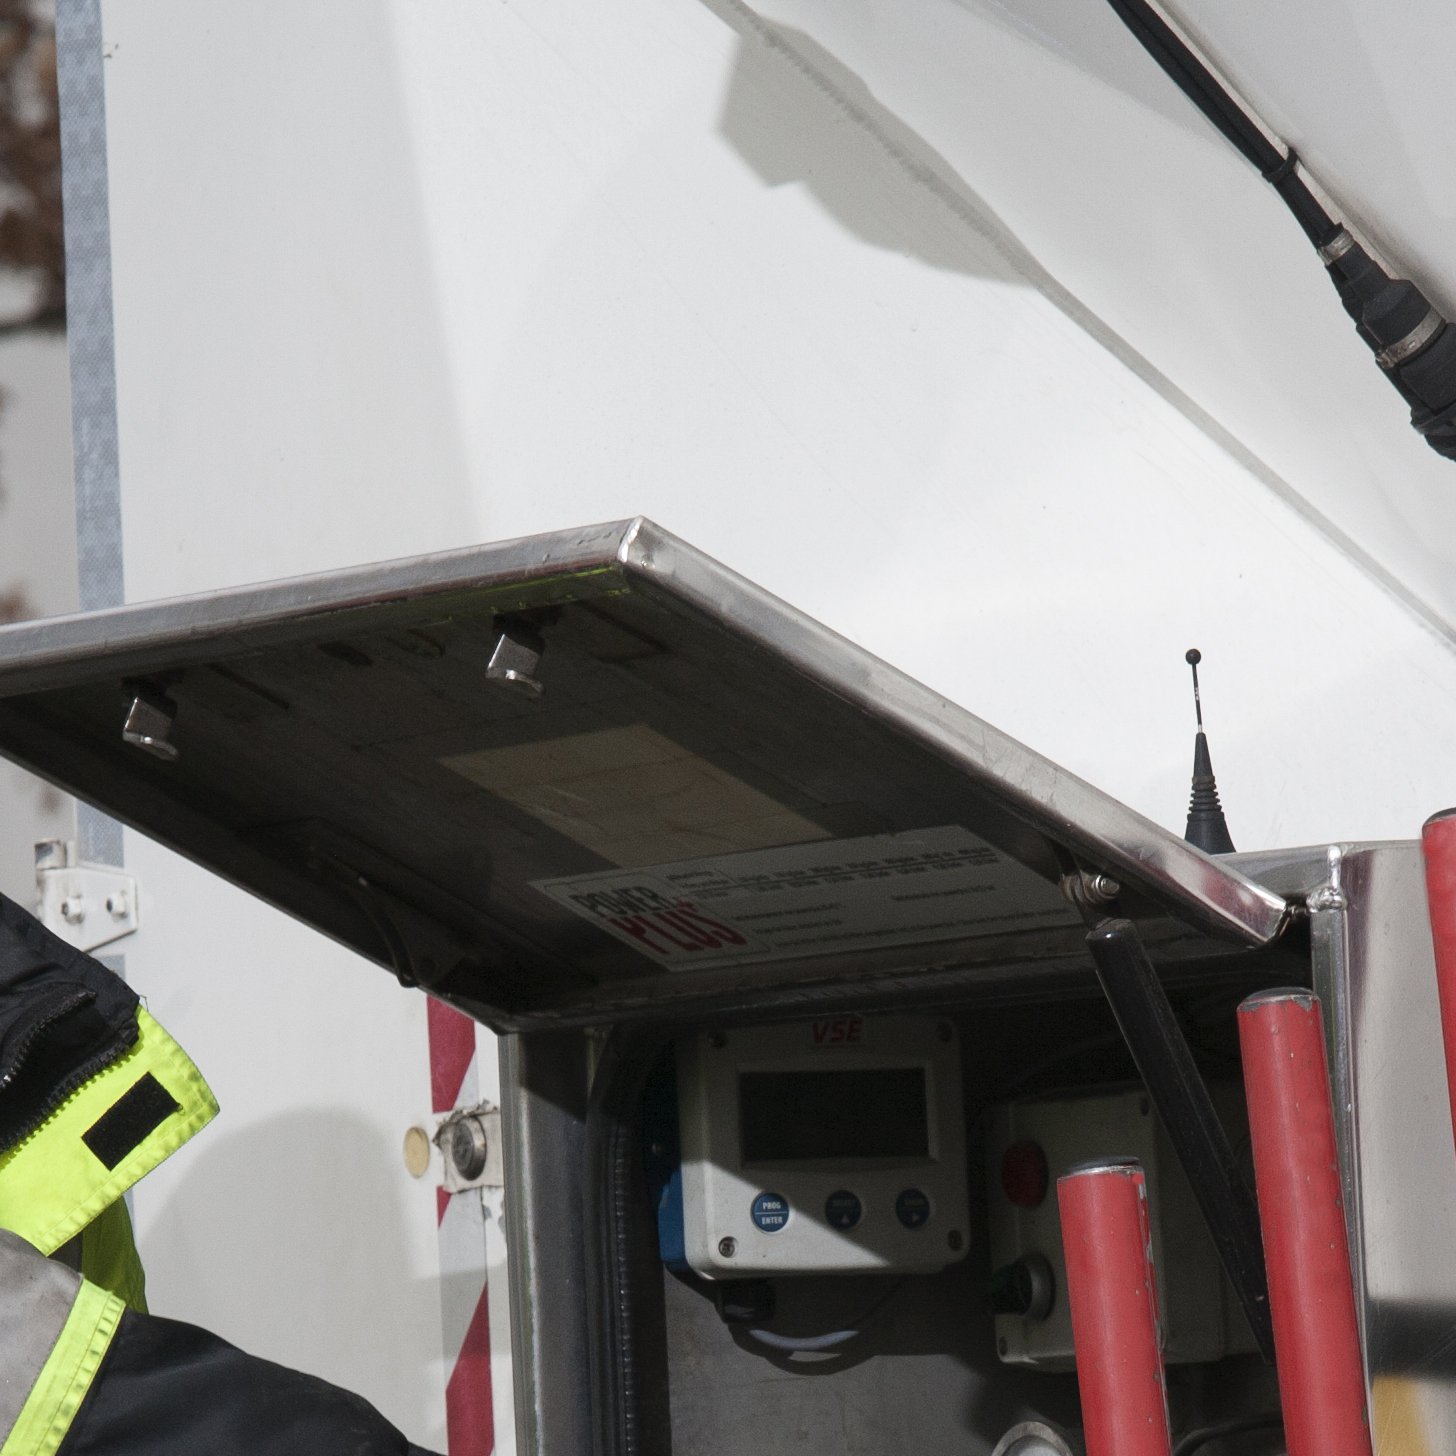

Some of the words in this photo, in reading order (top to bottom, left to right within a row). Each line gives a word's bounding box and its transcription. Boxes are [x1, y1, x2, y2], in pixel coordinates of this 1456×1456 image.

[569, 886, 677, 919] POWER
[813, 1016, 864, 1043] VSE
[762, 1201, 782, 1210] PROG
[761, 1216, 783, 1225] ENTER
